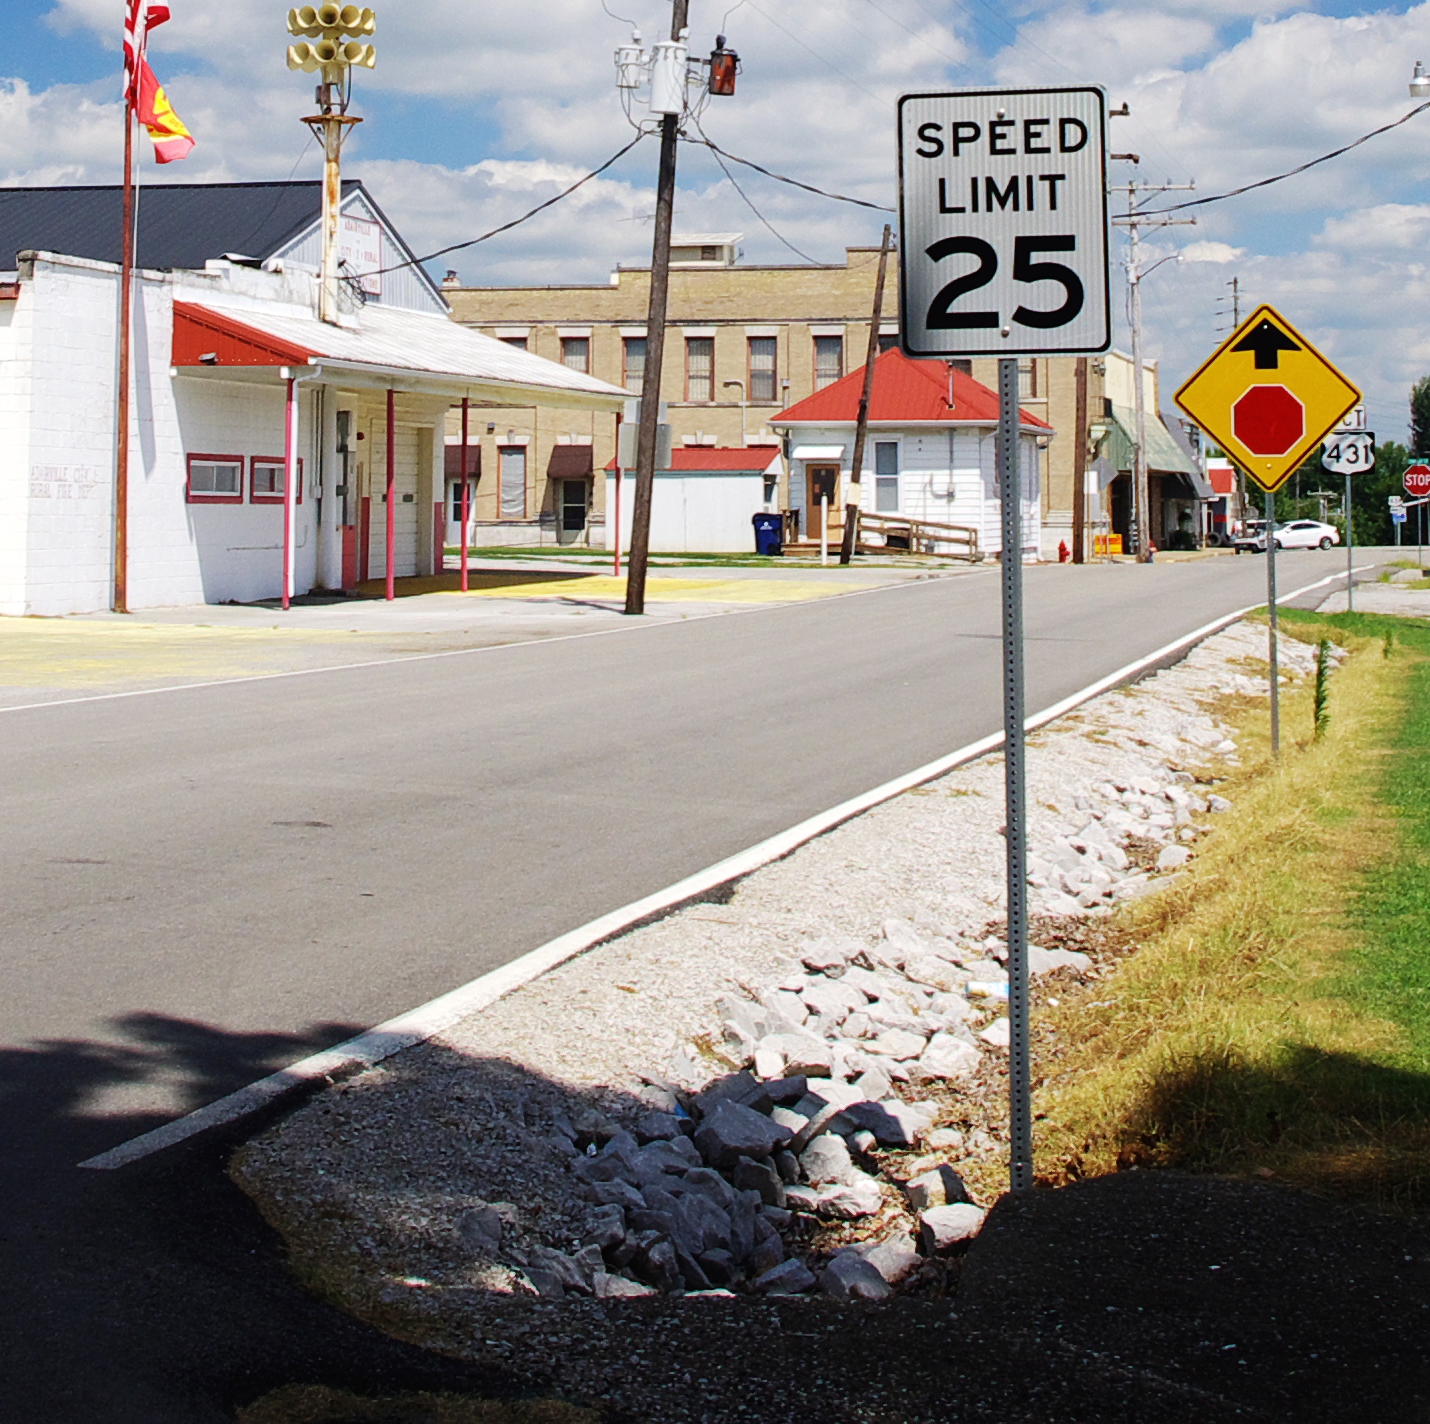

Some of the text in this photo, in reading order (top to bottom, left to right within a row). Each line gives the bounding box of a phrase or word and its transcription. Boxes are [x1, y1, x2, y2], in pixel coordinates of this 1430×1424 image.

[916, 117, 1088, 158] SPEED
[939, 174, 1066, 214] LIMIT
[925, 235, 1084, 330] 25
[1342, 409, 1364, 427] CT
[1327, 443, 1369, 464] 431
